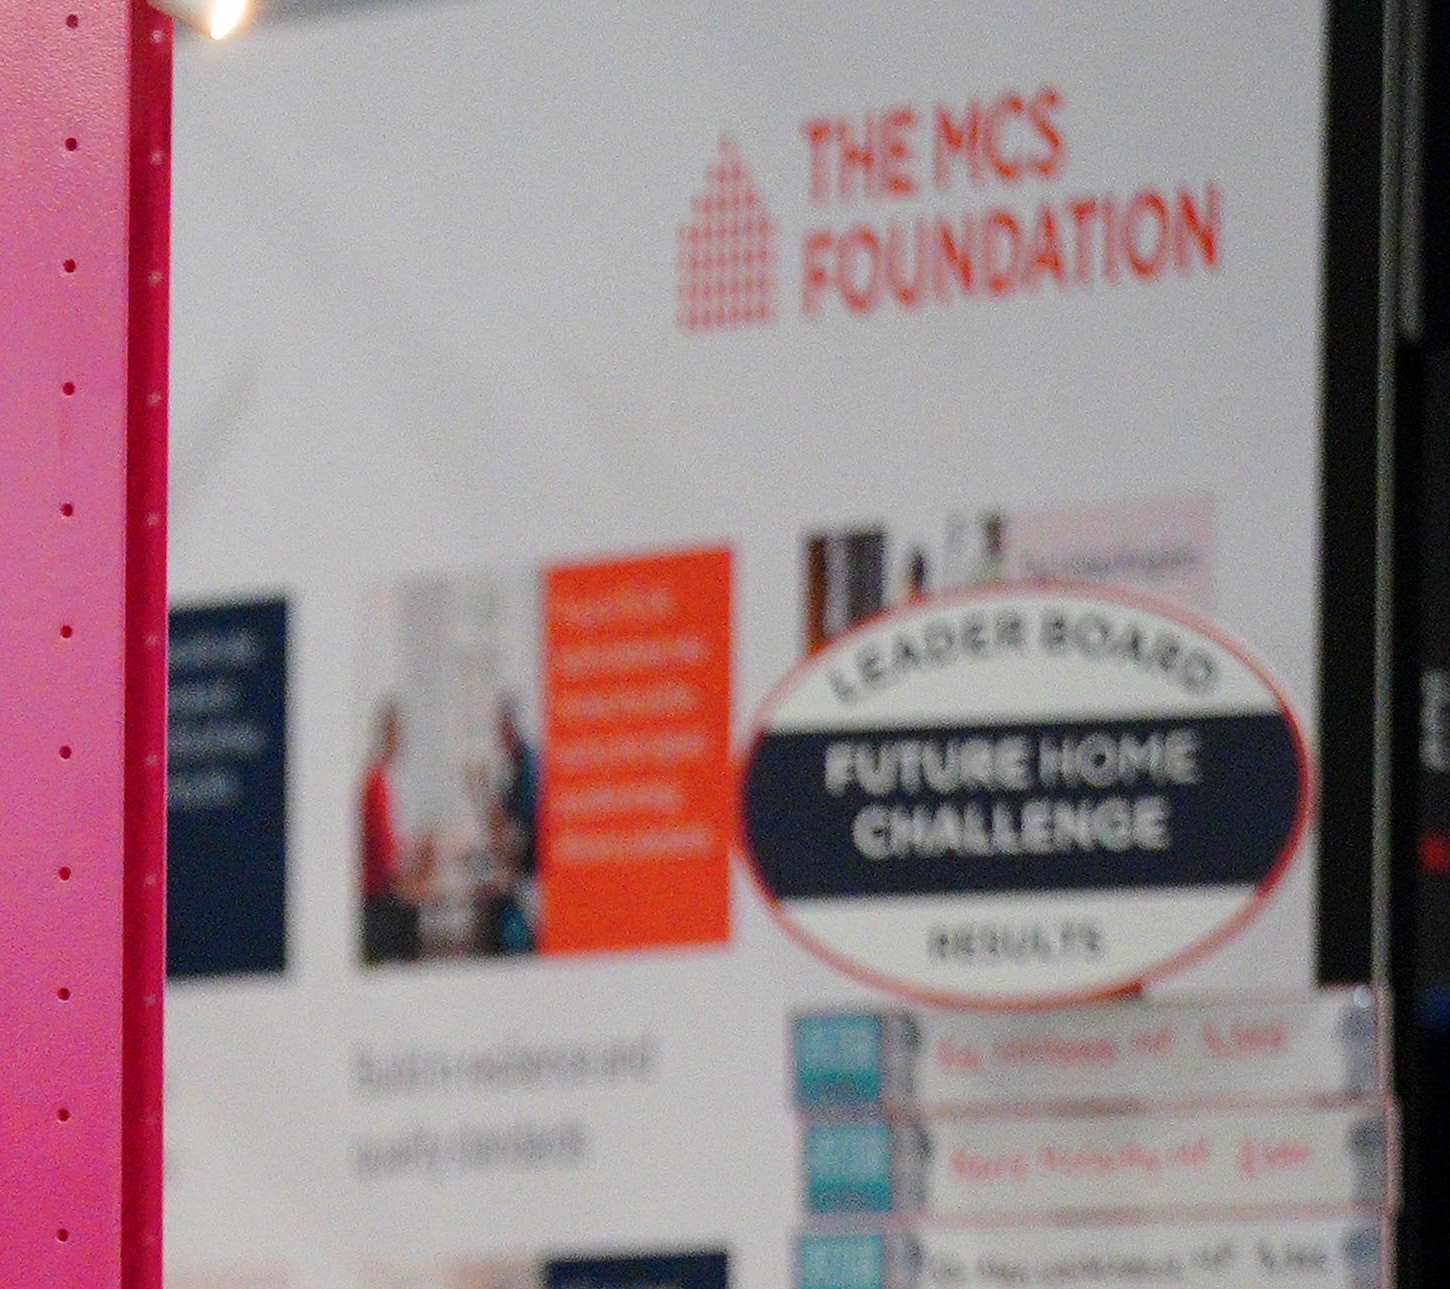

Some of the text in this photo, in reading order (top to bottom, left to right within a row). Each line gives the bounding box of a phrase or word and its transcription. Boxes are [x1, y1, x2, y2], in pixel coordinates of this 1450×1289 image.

[802, 87, 1068, 207] THE MCS
[801, 181, 1221, 318] FOUNDATION
[825, 608, 1219, 705] LEADER BOARD
[824, 729, 1203, 798] FUTURE HOME
[853, 796, 1168, 861] CHALLENGE
[927, 920, 1102, 964] RESULTS
